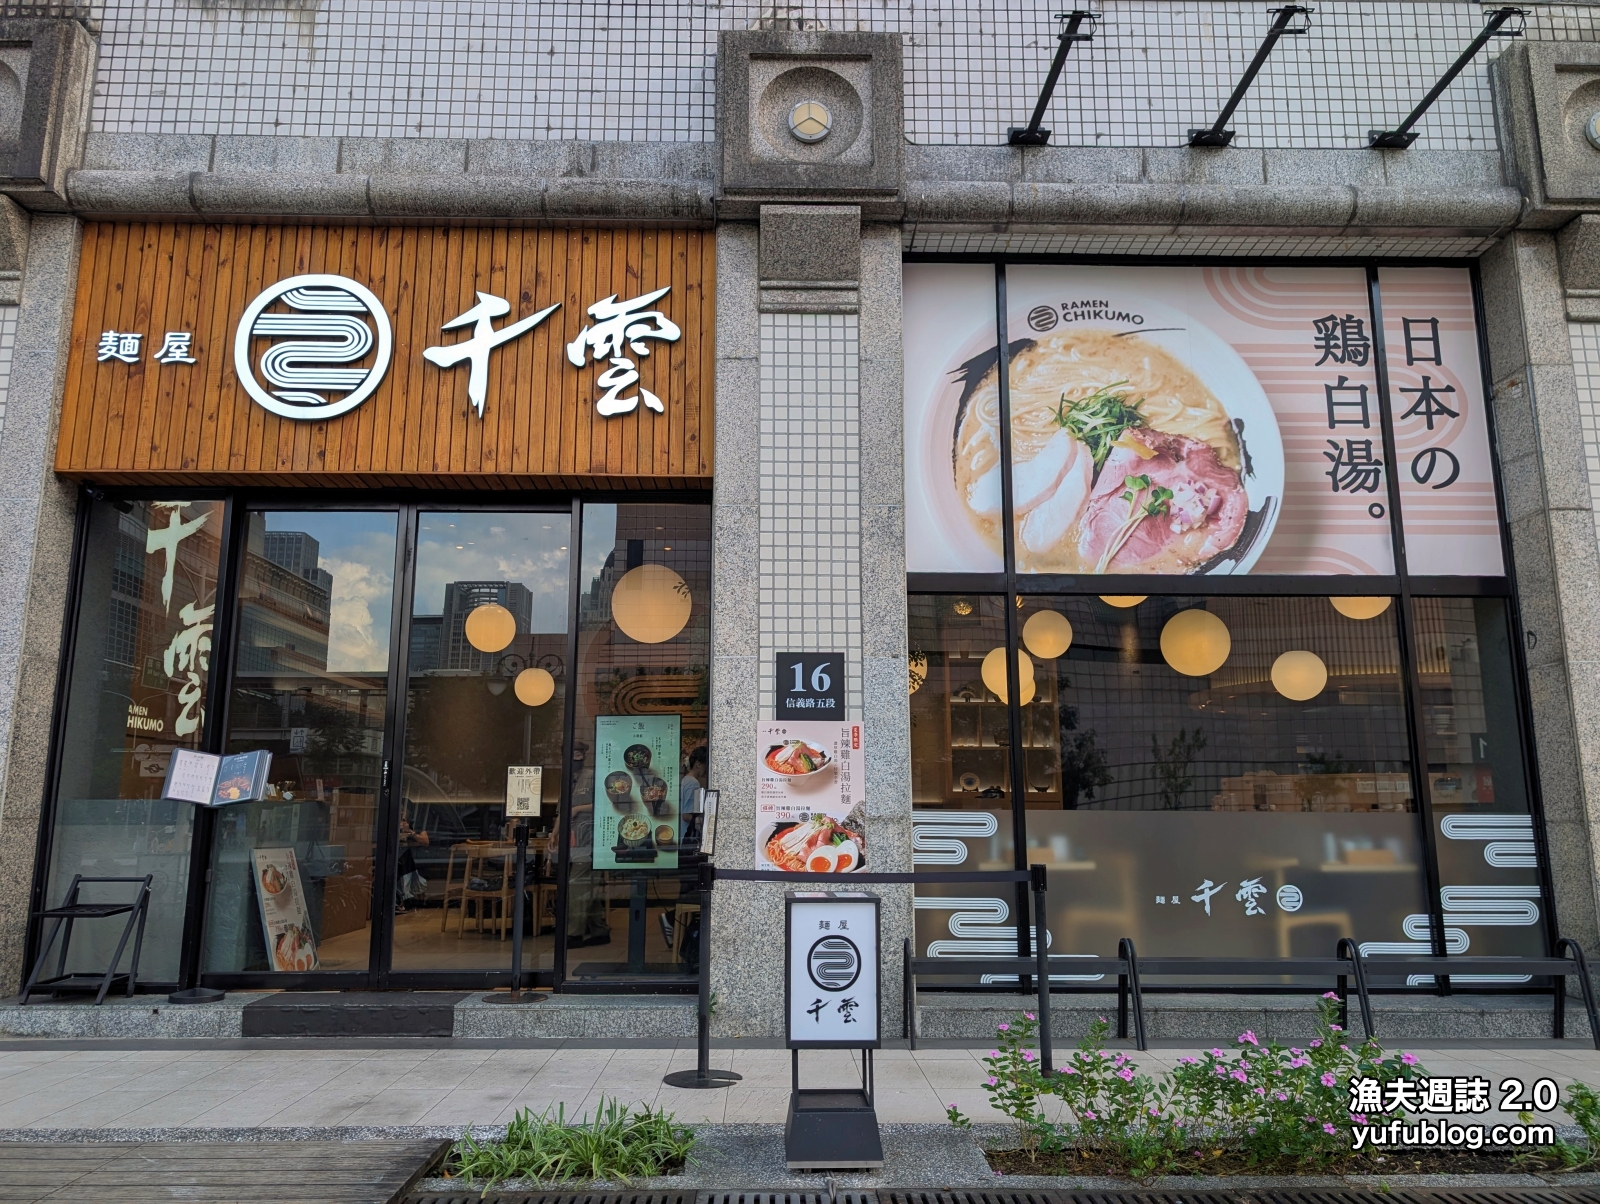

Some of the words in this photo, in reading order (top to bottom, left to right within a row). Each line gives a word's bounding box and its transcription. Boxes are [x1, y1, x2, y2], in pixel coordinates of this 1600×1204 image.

[1061, 300, 1109, 311] RAMEN
[1063, 310, 1144, 325] CHIKUMO
[423, 286, 681, 418] 千雲
[1399, 316, 1460, 490] 日本の
[790, 662, 831, 692] 16
[128, 704, 149, 717] AMEN
[786, 697, 836, 708] 信義路五段
[126, 715, 164, 732] HIKUMO
[1191, 876, 1268, 917] 千雲
[806, 996, 859, 1024] 千雲
